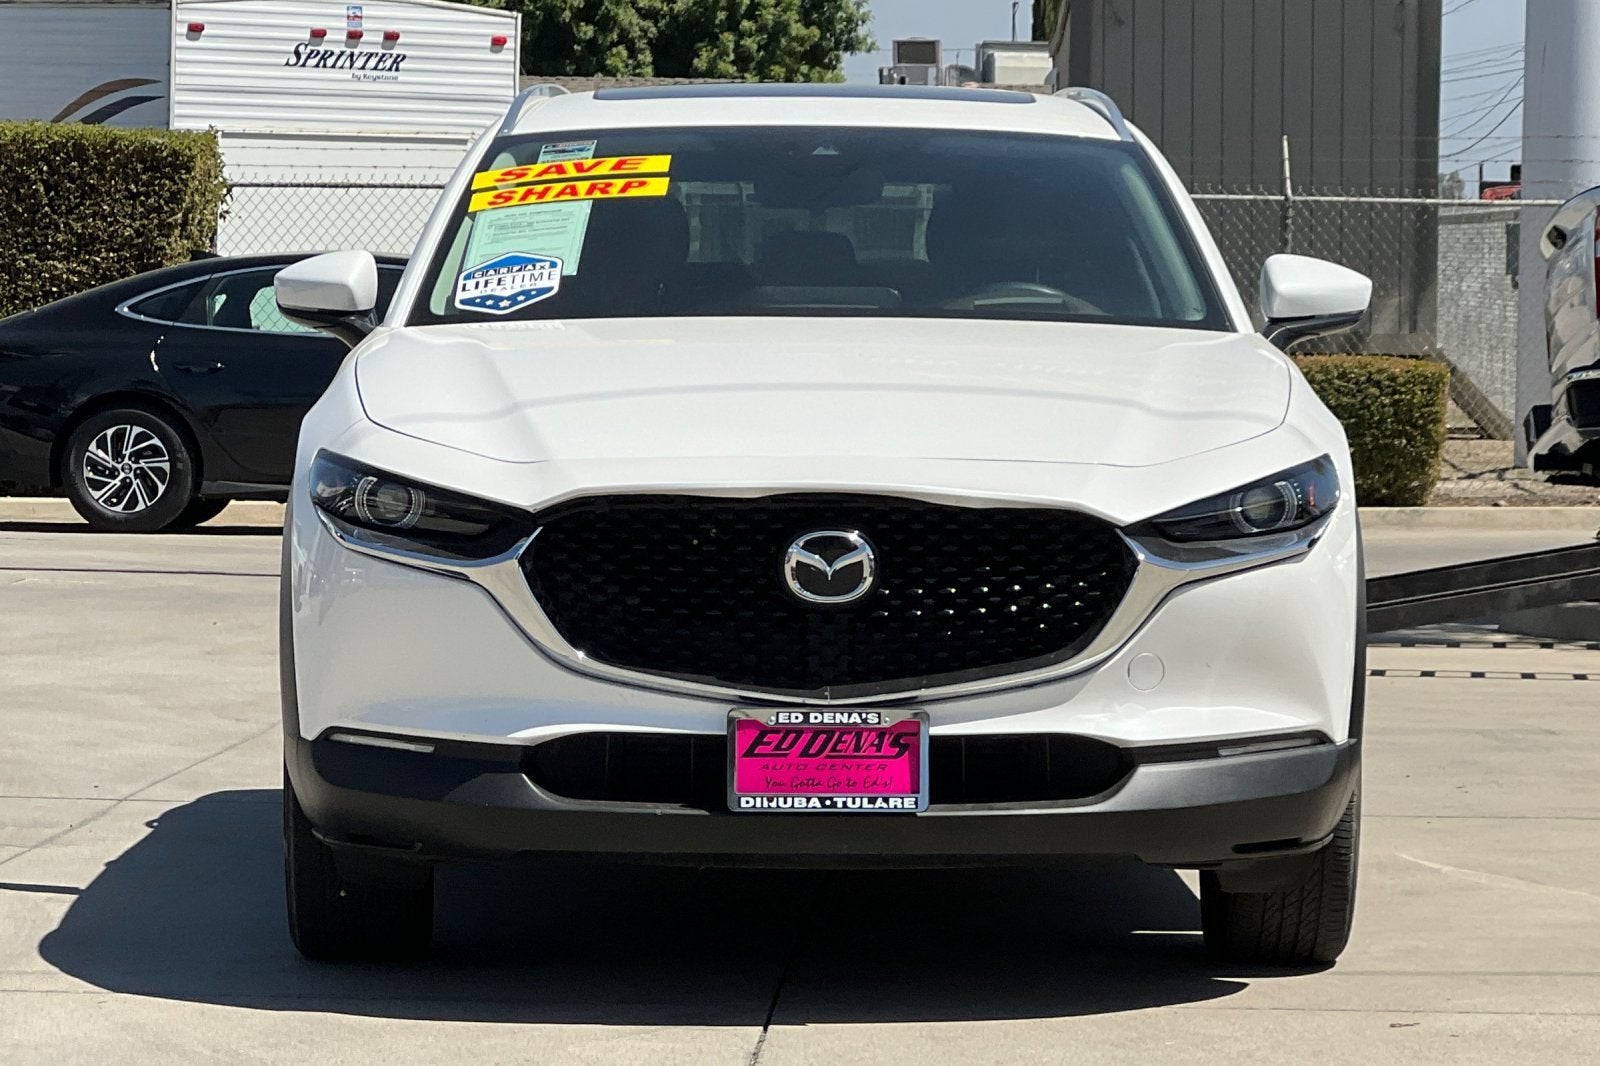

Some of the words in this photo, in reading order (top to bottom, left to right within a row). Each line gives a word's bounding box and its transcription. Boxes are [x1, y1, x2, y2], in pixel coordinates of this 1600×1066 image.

[284, 42, 407, 72] SPRINTER
[363, 73, 399, 81] Keystone
[494, 157, 649, 183] SAVE
[487, 180, 649, 206] SHARP
[471, 263, 548, 280] CARFAX
[461, 270, 557, 292] LIFETIME
[778, 712, 804, 724] ED
[809, 712, 879, 724] DENA'S
[741, 729, 804, 758] ED
[760, 763, 808, 771] AUTO
[815, 763, 888, 771] CENTER
[765, 776, 785, 788] You
[791, 776, 823, 789] Gotta
[833, 797, 916, 808] TULARE
